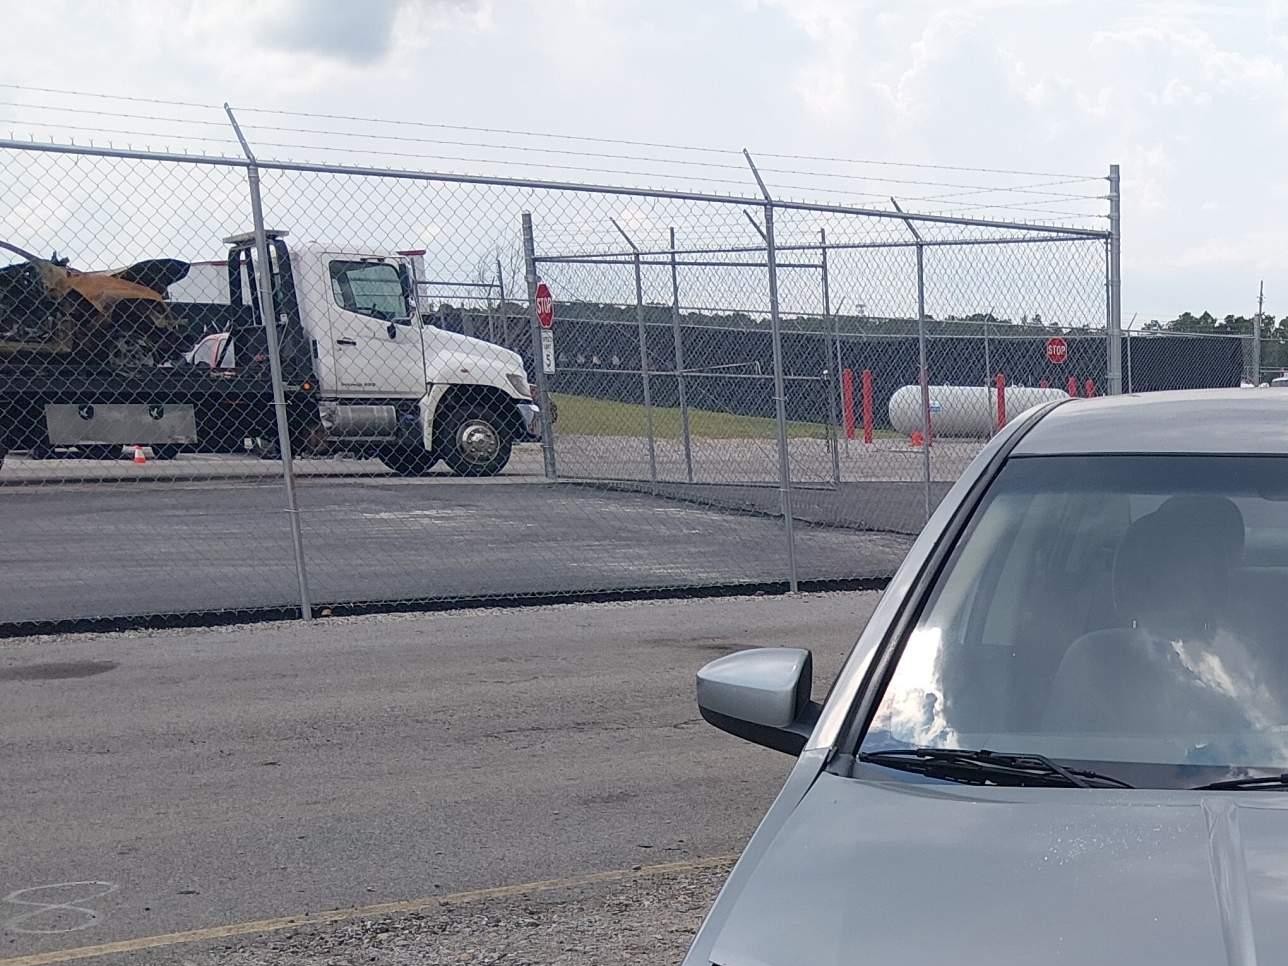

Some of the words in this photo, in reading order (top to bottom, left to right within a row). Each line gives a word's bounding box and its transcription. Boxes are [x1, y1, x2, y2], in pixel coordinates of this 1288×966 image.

[537, 298, 551, 314] STOP
[1048, 345, 1066, 355] STOP
[545, 354, 552, 368] 5
